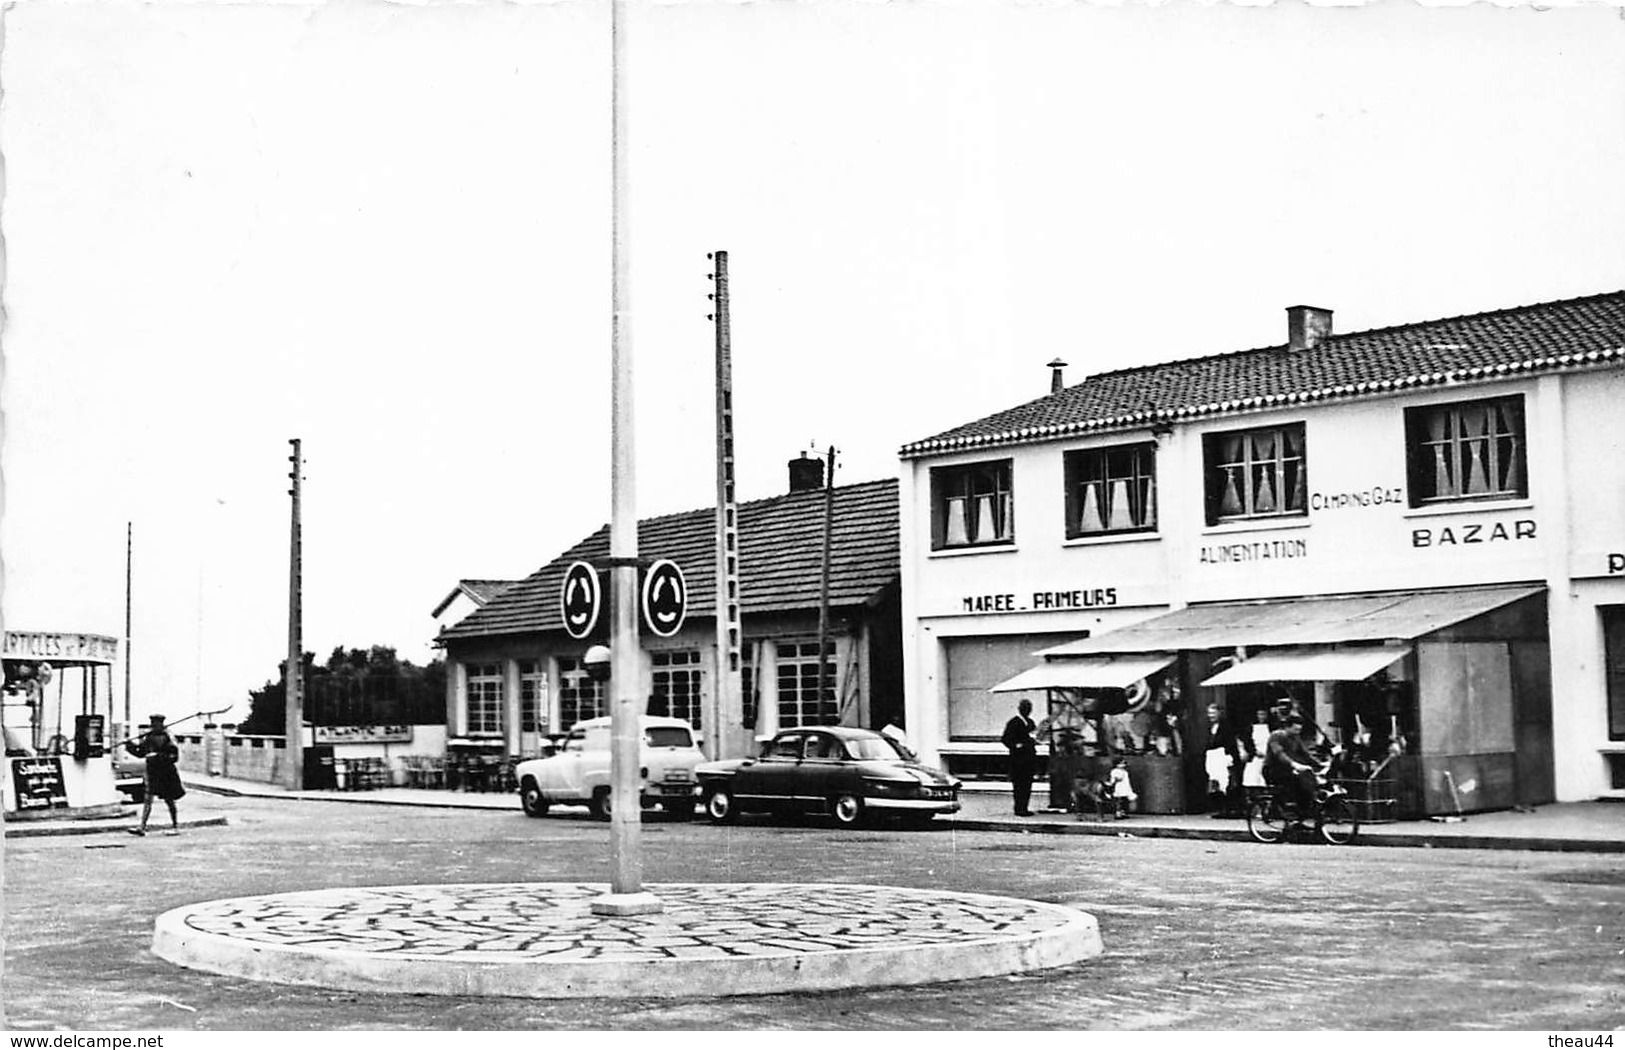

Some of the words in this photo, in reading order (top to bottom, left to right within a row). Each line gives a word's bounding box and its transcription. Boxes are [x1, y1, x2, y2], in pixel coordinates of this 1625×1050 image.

[1412, 519, 1537, 548] BAZAR
[1200, 538, 1307, 564] ALIMENTATION
[963, 594, 1015, 612] MAREE
[1033, 587, 1117, 609] PRIMEURS
